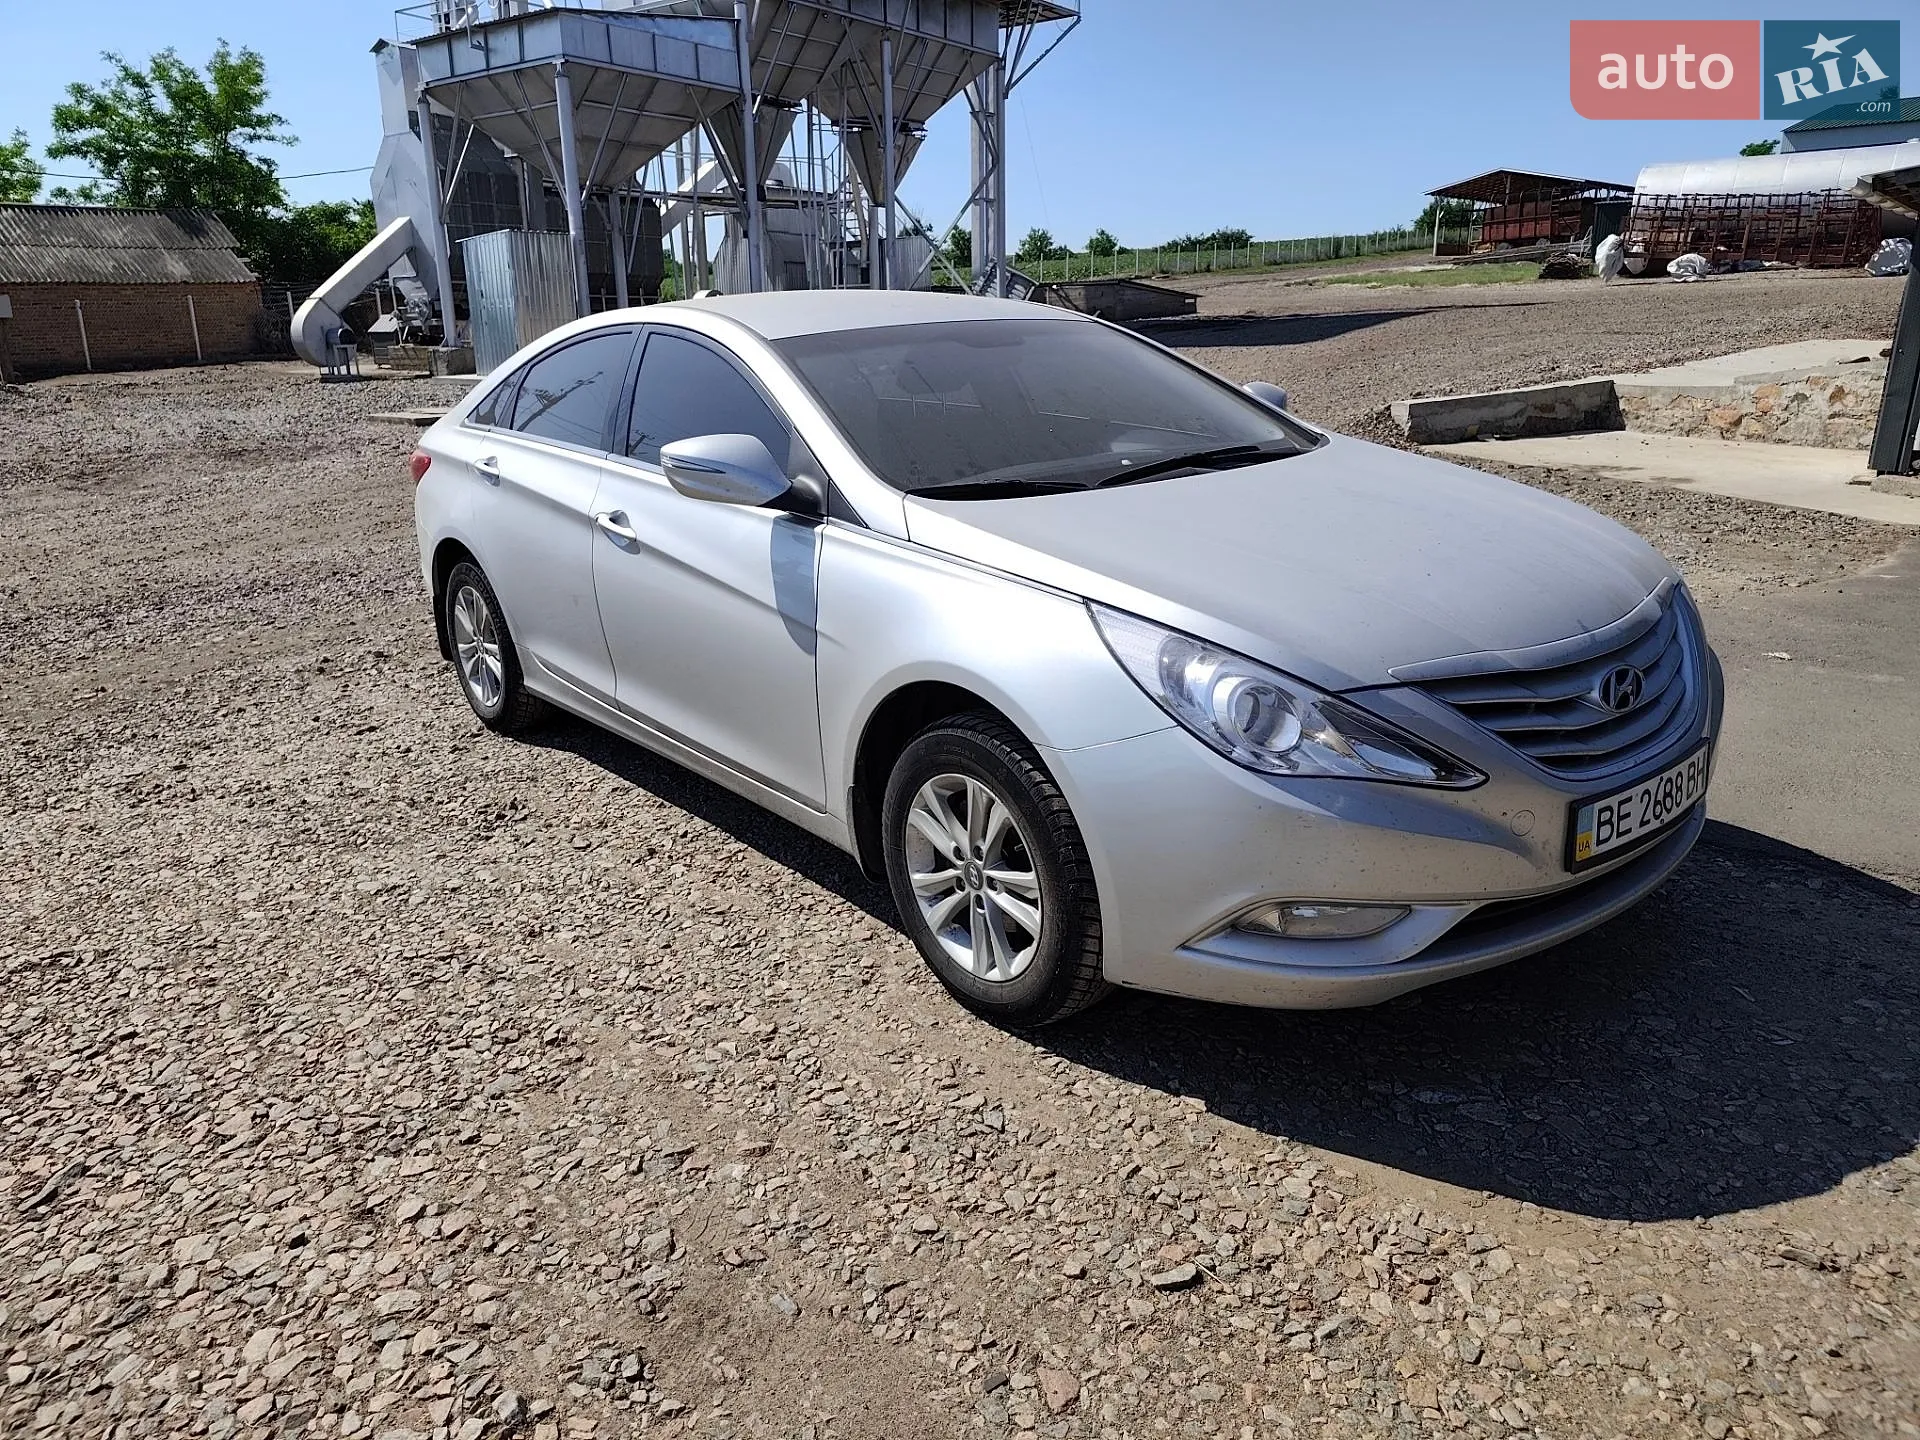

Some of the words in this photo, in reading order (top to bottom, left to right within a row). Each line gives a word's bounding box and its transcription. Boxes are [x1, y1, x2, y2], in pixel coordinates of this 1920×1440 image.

[1596, 795, 1633, 846] BE
[1638, 771, 1683, 828] 2688
[1686, 750, 1706, 801] BH
[1578, 840, 1590, 852] UA
